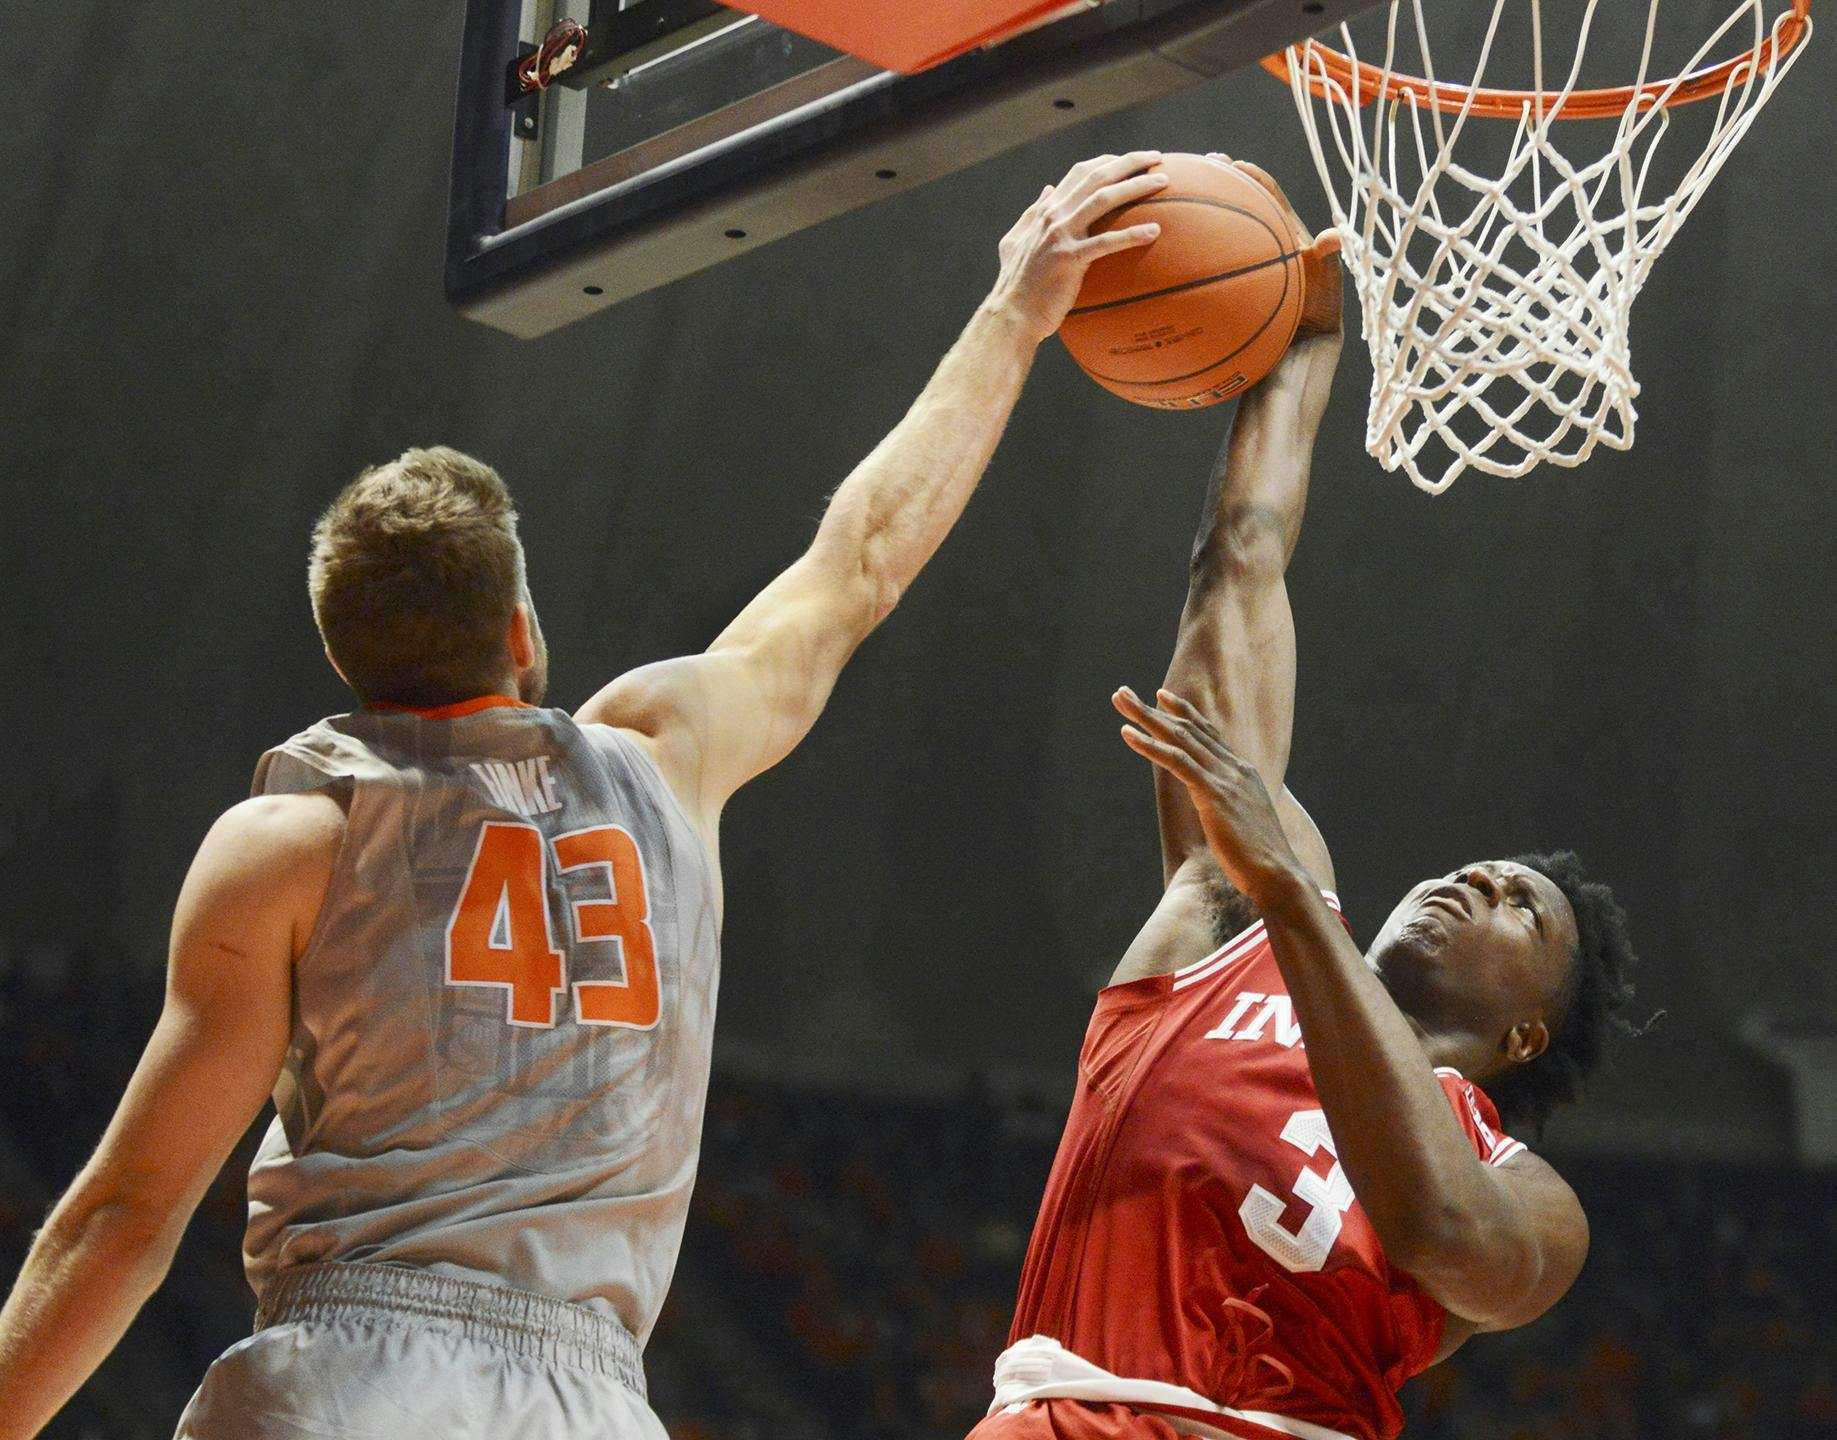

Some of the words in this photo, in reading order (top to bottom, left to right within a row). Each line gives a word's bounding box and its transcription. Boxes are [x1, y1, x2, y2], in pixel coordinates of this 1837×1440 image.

[444, 820, 662, 1031] 43
[1203, 991, 1305, 1049] IN
[1238, 1109, 1355, 1272] 3
